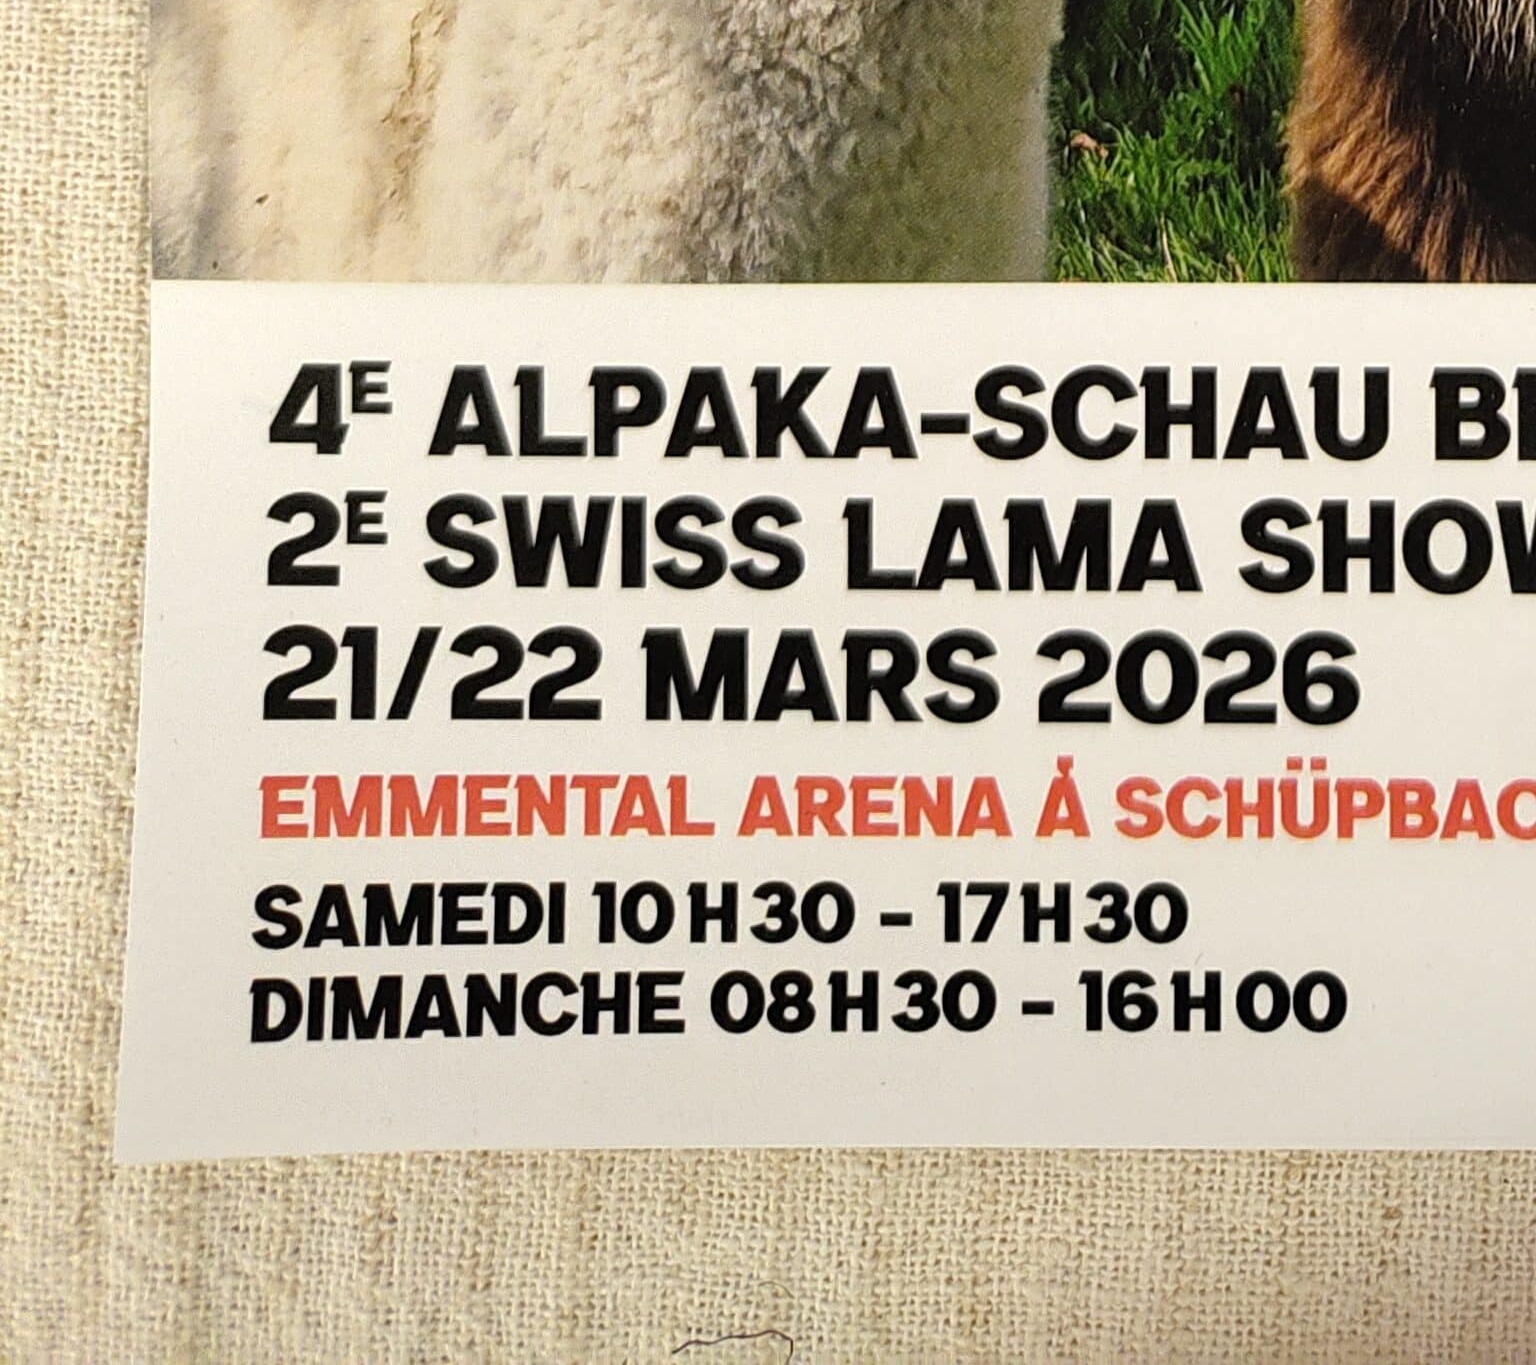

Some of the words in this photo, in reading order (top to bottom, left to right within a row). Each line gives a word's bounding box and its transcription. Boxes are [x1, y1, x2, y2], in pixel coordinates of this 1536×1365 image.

[427, 366, 1390, 462] ALPAKA-SCHAU
[423, 494, 805, 592] SWISS
[841, 498, 1203, 593] LAMA
[262, 624, 602, 721] 21/22
[640, 628, 1000, 725] MARS
[1036, 631, 1360, 727] 2026
[259, 774, 715, 839] EMMENTAL
[737, 776, 1012, 838] ARENA
[1035, 756, 1090, 838] À
[251, 881, 566, 951] SAMEDI
[249, 971, 686, 1044] DIMANCHE
